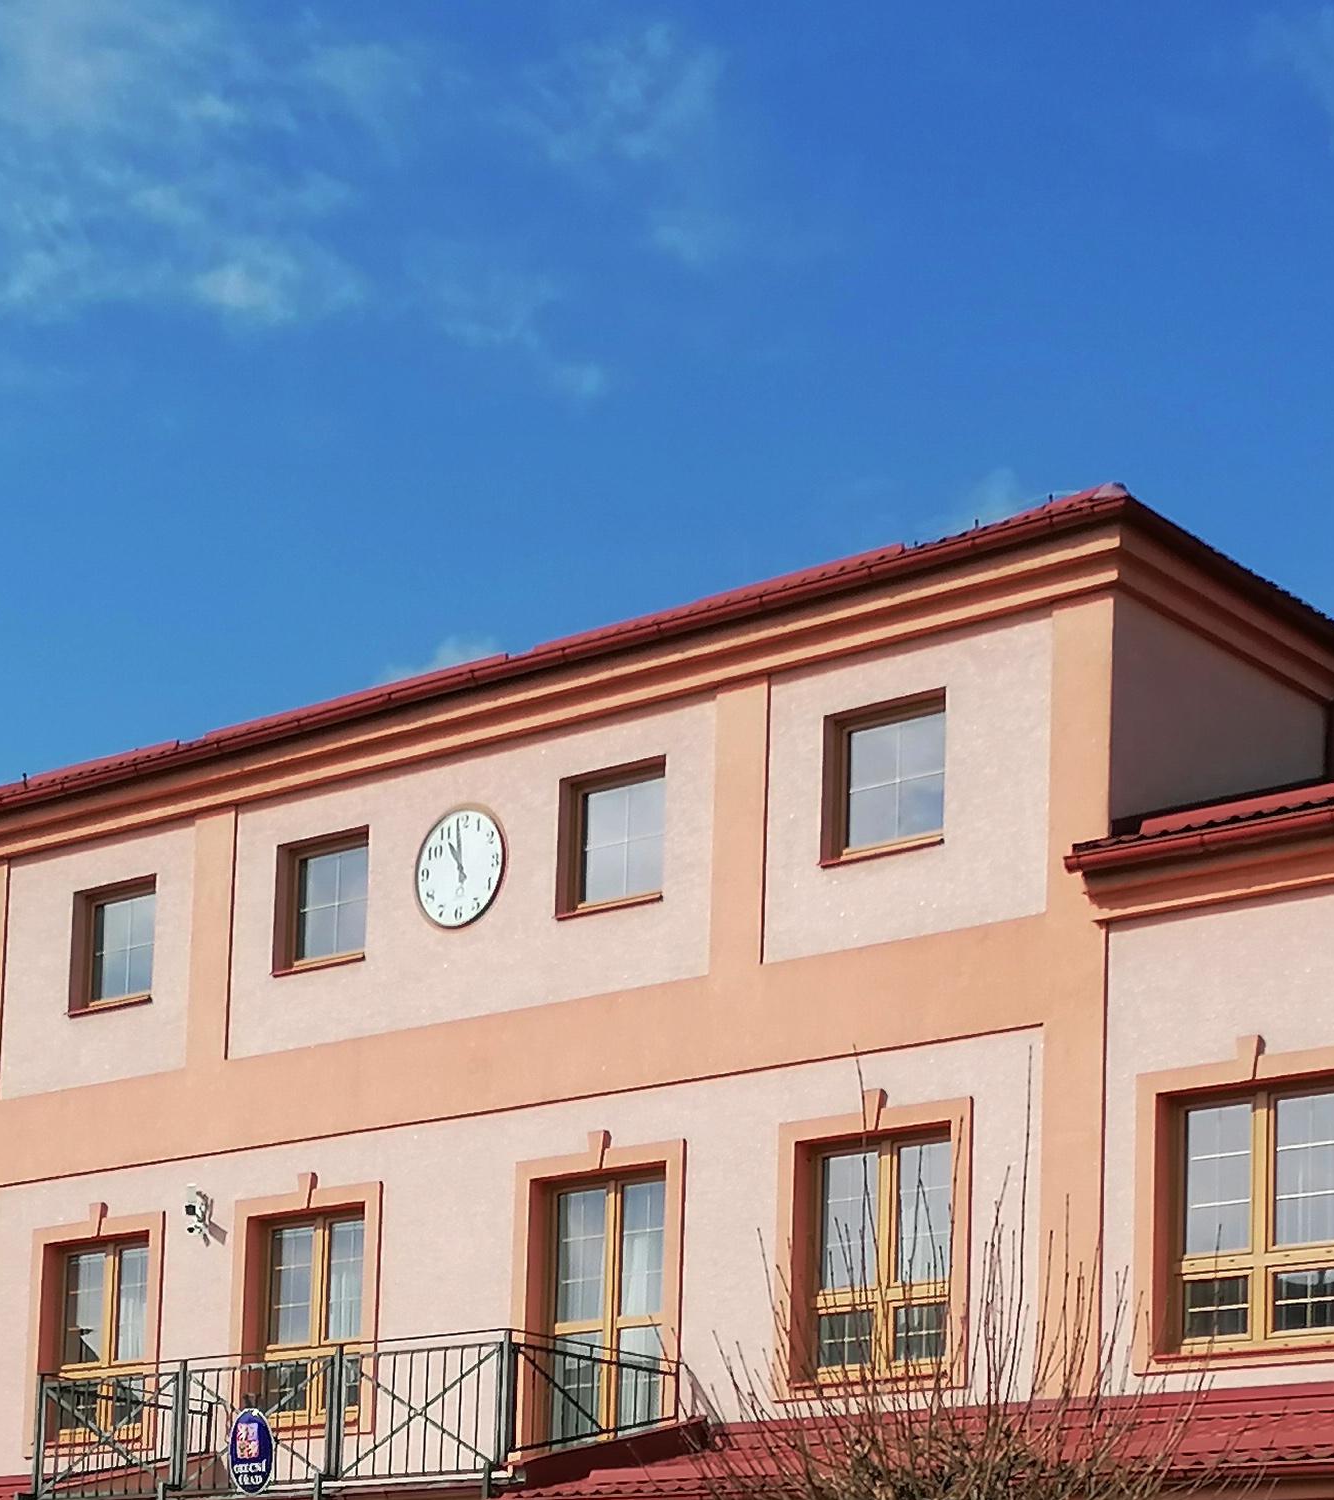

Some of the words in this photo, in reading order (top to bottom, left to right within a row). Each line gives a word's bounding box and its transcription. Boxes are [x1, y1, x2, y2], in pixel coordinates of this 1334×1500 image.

[476, 817, 481, 832] 1
[440, 826, 451, 841] 11
[486, 830, 495, 844] 2
[427, 844, 443, 861] 10
[490, 853, 500, 868] 3
[420, 867, 430, 882] 9
[424, 889, 435, 904] 8
[437, 904, 446, 918] 7
[453, 905, 463, 921] 6
